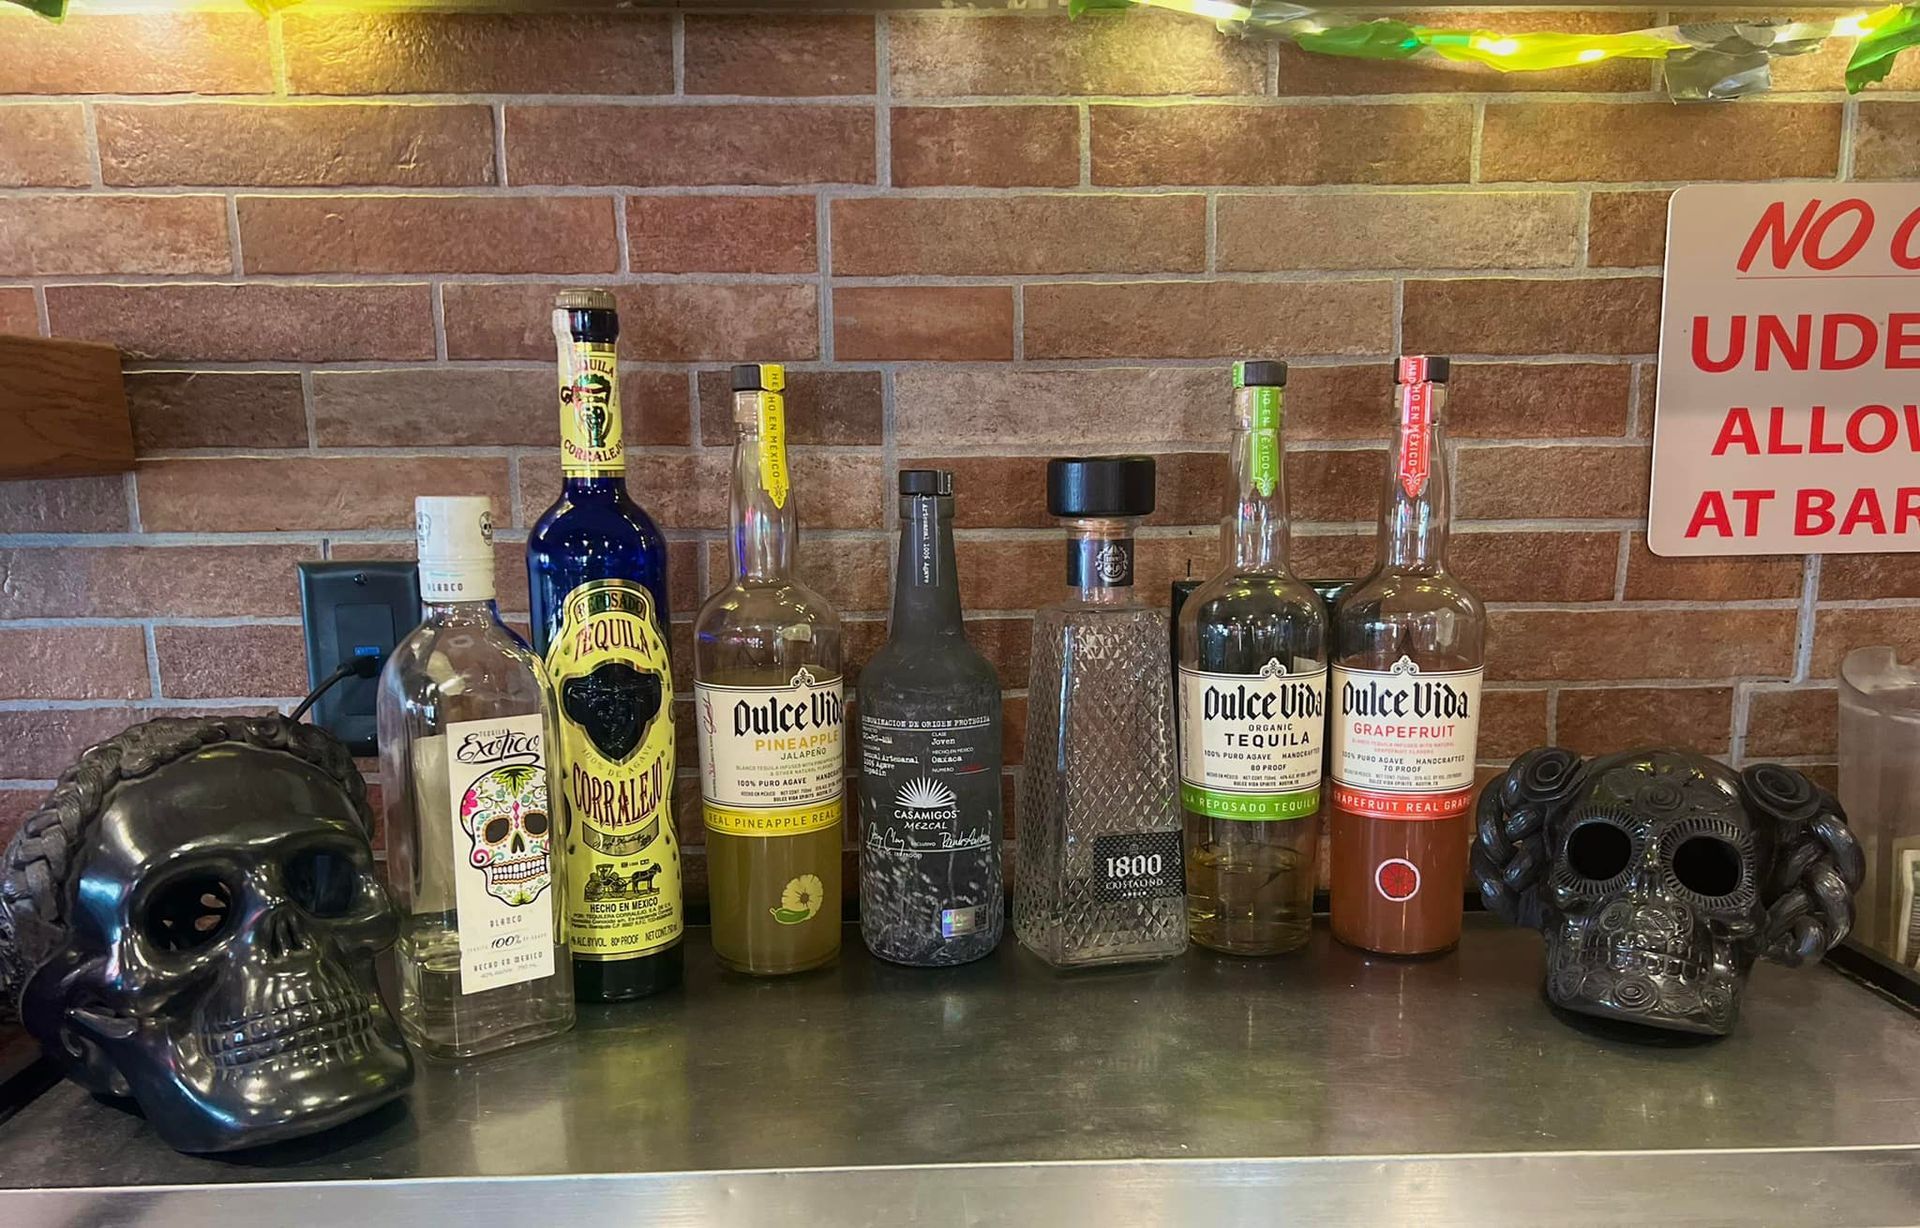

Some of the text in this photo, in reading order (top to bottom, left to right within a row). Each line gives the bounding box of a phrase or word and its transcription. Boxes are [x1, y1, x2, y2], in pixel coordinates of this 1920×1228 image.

[1736, 198, 1875, 273] NO
[1691, 312, 1920, 374] UNDE
[1711, 404, 1920, 456] ALLO
[1684, 486, 1920, 539] AT BAR
[574, 618, 652, 662] TEQUILA
[1204, 682, 1323, 721] Dulce Vida
[1342, 680, 1469, 719] Dulce Vida
[733, 696, 809, 738] Dulce
[908, 720, 920, 728] DE
[1248, 723, 1293, 732] ORGANIC
[1354, 721, 1455, 739] GRAPEFRUIT
[755, 729, 839, 751] PINEAPPLE
[931, 738, 956, 746] Joven
[1224, 732, 1310, 749] TEQUILA
[780, 747, 827, 761] JALAPEÑO
[931, 755, 963, 764] Oaxaca
[1204, 749, 1221, 758] 100%
[1223, 752, 1244, 760] PURO
[1357, 753, 1376, 763] PURO
[1378, 756, 1404, 765] AGAVE
[1416, 754, 1465, 765] HANDCRAFTED
[1262, 763, 1287, 771] PROOF
[1395, 765, 1422, 773] PROOF
[737, 779, 756, 787] 100%
[758, 779, 780, 787] PURO
[783, 777, 807, 786] AGAVE
[573, 756, 662, 830] CORRALEJO
[1200, 797, 1266, 813] REPOSADO
[1273, 797, 1316, 812] TEQUILA
[1406, 801, 1439, 812] REAL
[734, 814, 807, 829] PINEAPPLE
[812, 808, 835, 824] REAL
[894, 809, 957, 820] CASAMIGOS
[903, 821, 948, 830] MEZCAL
[1106, 853, 1162, 878] 1800
[1105, 878, 1164, 890] CRISTALINO
[590, 903, 617, 913] HECHO
[619, 902, 629, 911] EN
[631, 896, 658, 910] MEXICO
[490, 934, 522, 949] 100%
